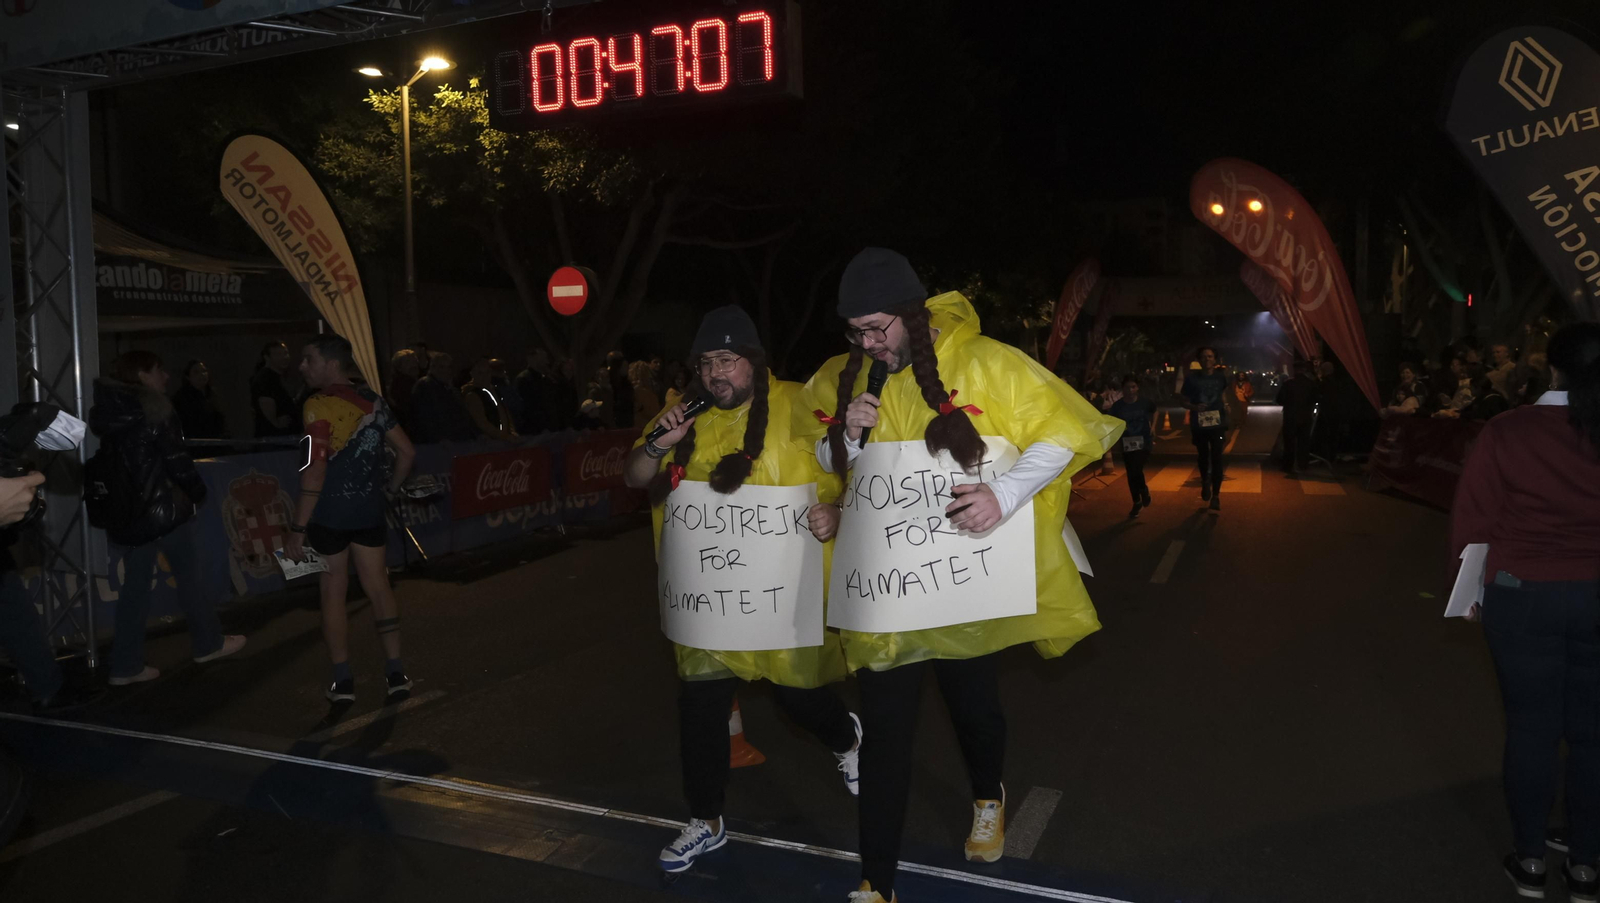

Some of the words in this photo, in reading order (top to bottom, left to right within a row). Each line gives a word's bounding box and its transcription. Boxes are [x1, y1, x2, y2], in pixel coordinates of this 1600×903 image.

[530, 10, 773, 113] 00:47:07
[884, 515, 957, 549] FÖR
[699, 546, 747, 573] FÖR
[845, 546, 993, 602] KLIMATET
